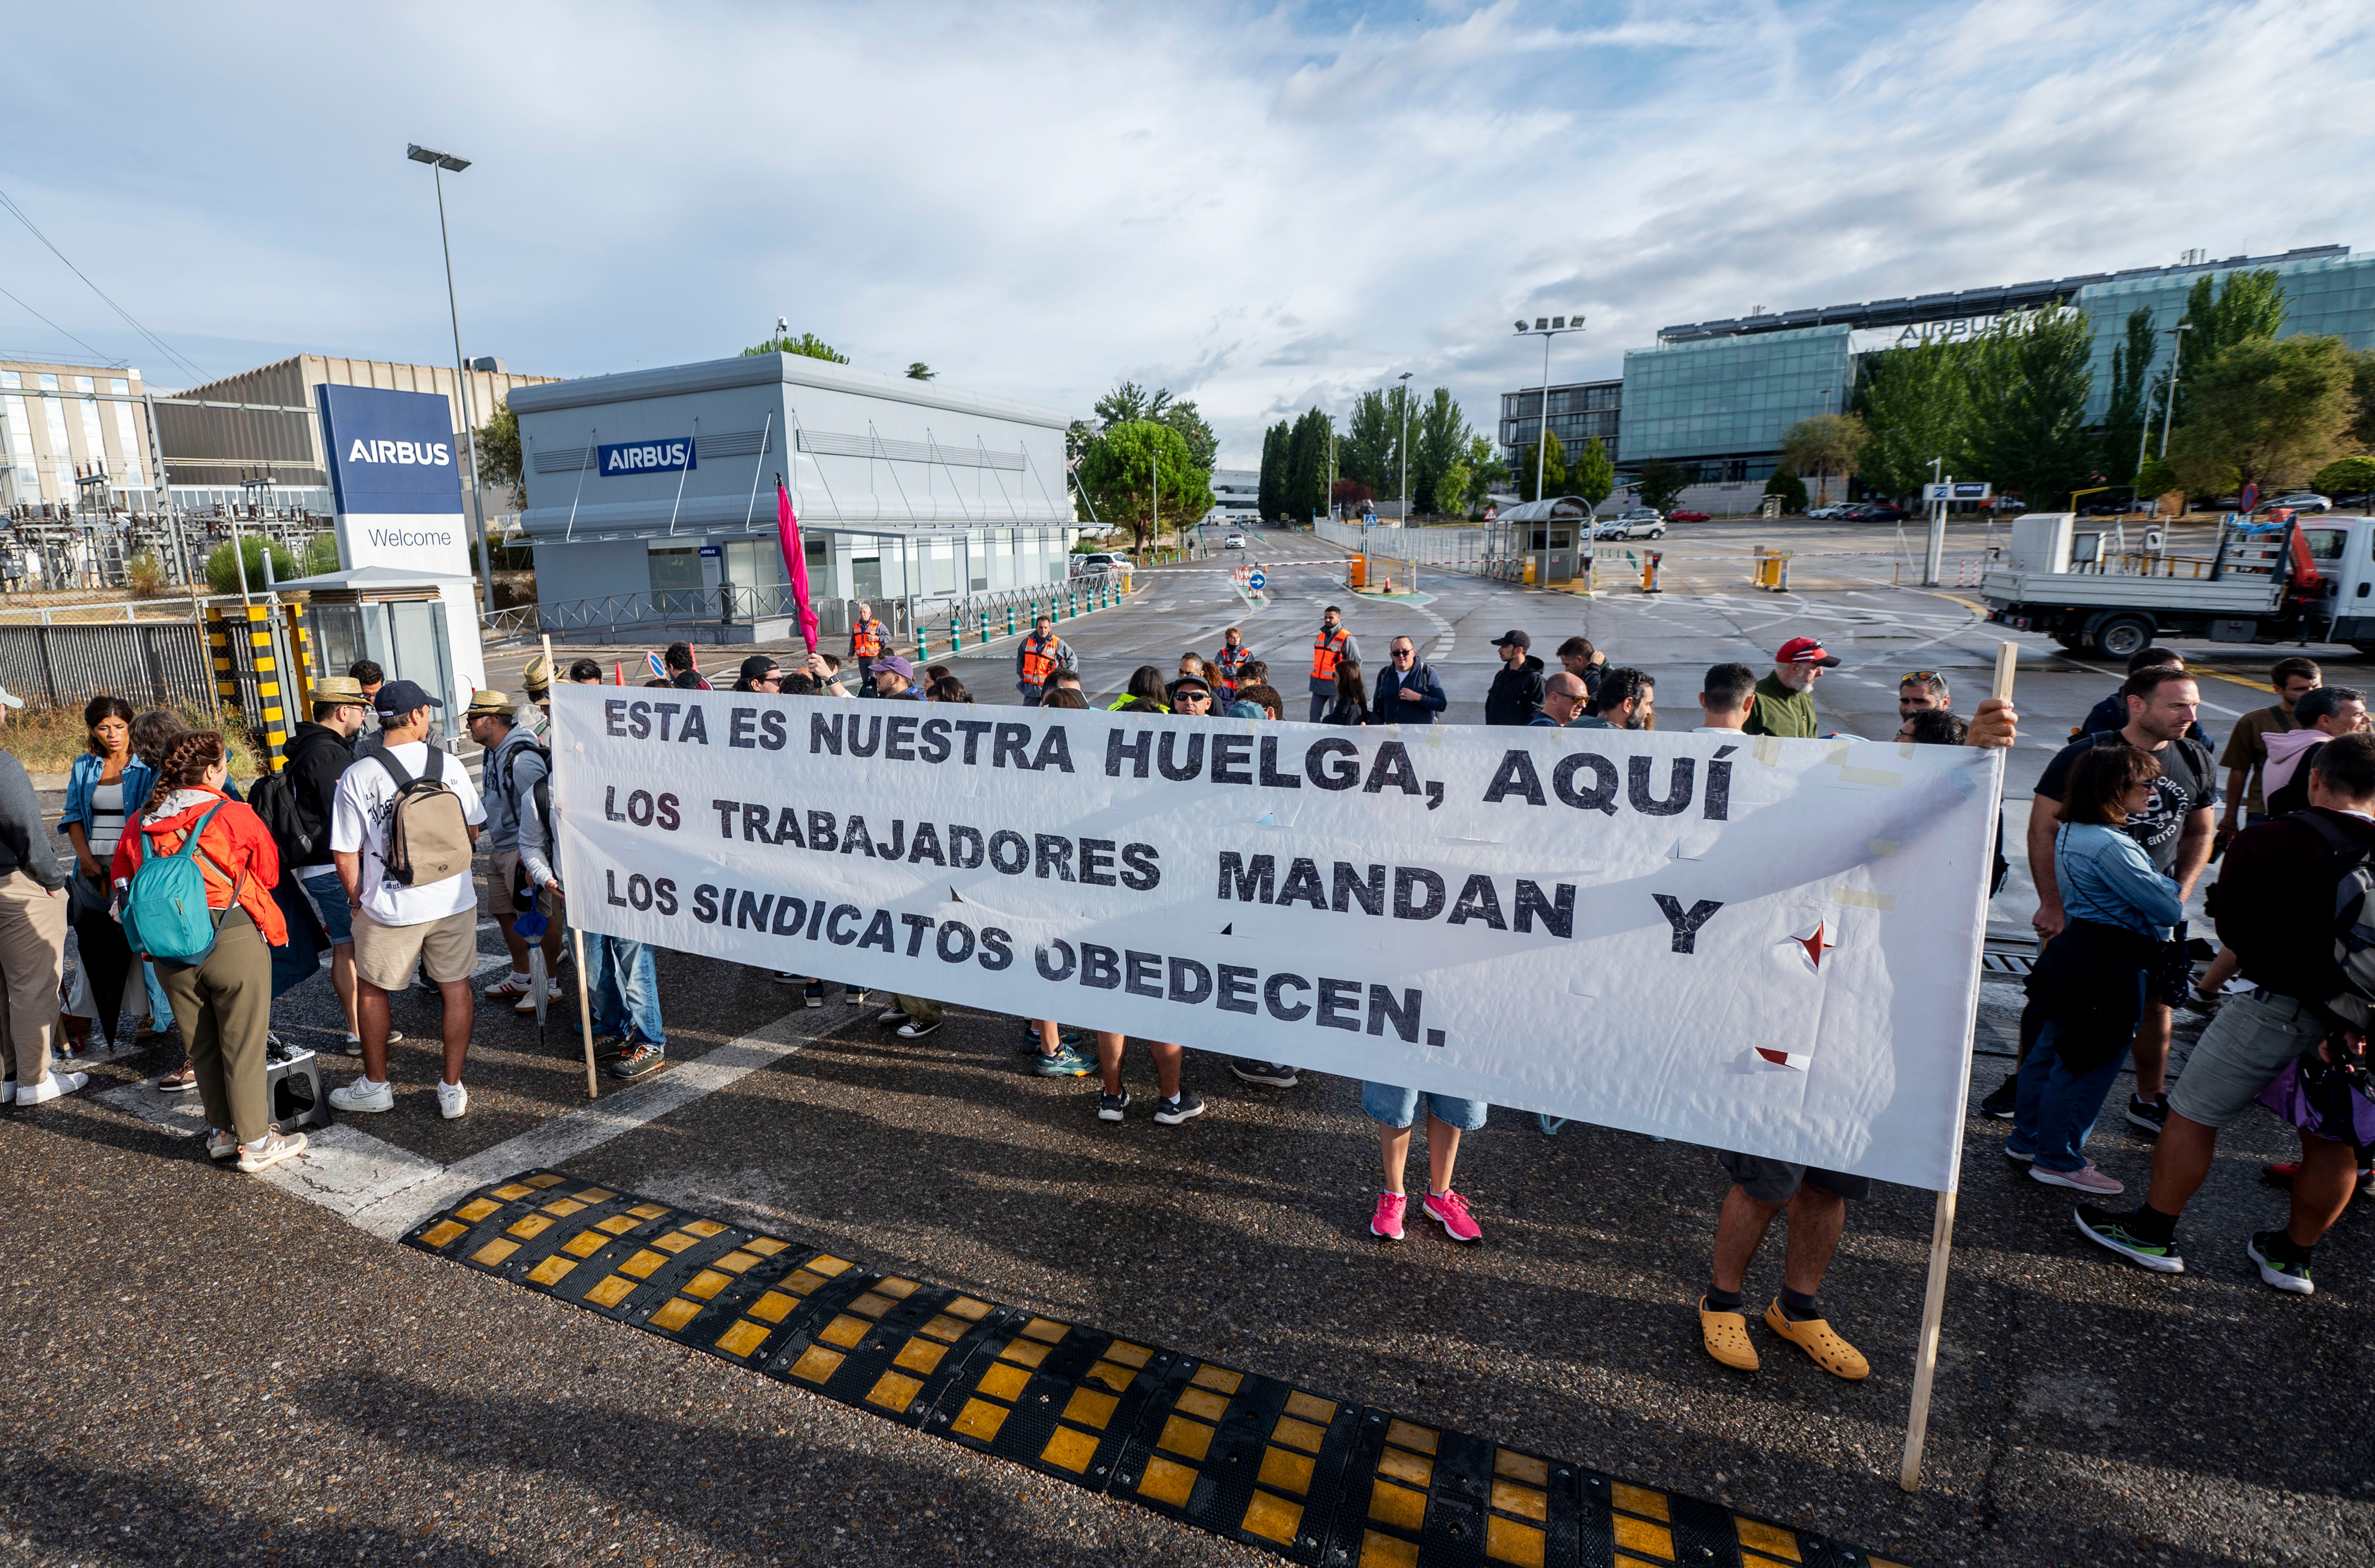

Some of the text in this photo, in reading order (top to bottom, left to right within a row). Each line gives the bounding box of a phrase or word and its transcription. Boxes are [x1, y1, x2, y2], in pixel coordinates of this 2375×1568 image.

[349, 439, 450, 466] AIRBUS
[608, 444, 685, 470] AIRBUS
[368, 529, 451, 547] Welcome
[606, 699, 1738, 820] ESTA ES NUESTRA HUELGA, AQUÍ
[2147, 825, 2177, 845] CLUB
[606, 786, 1724, 954] LOS TRABAJADORES MANDAN Y
[607, 870, 1445, 1047] LOS SINDICATOS OBEDECEN.
